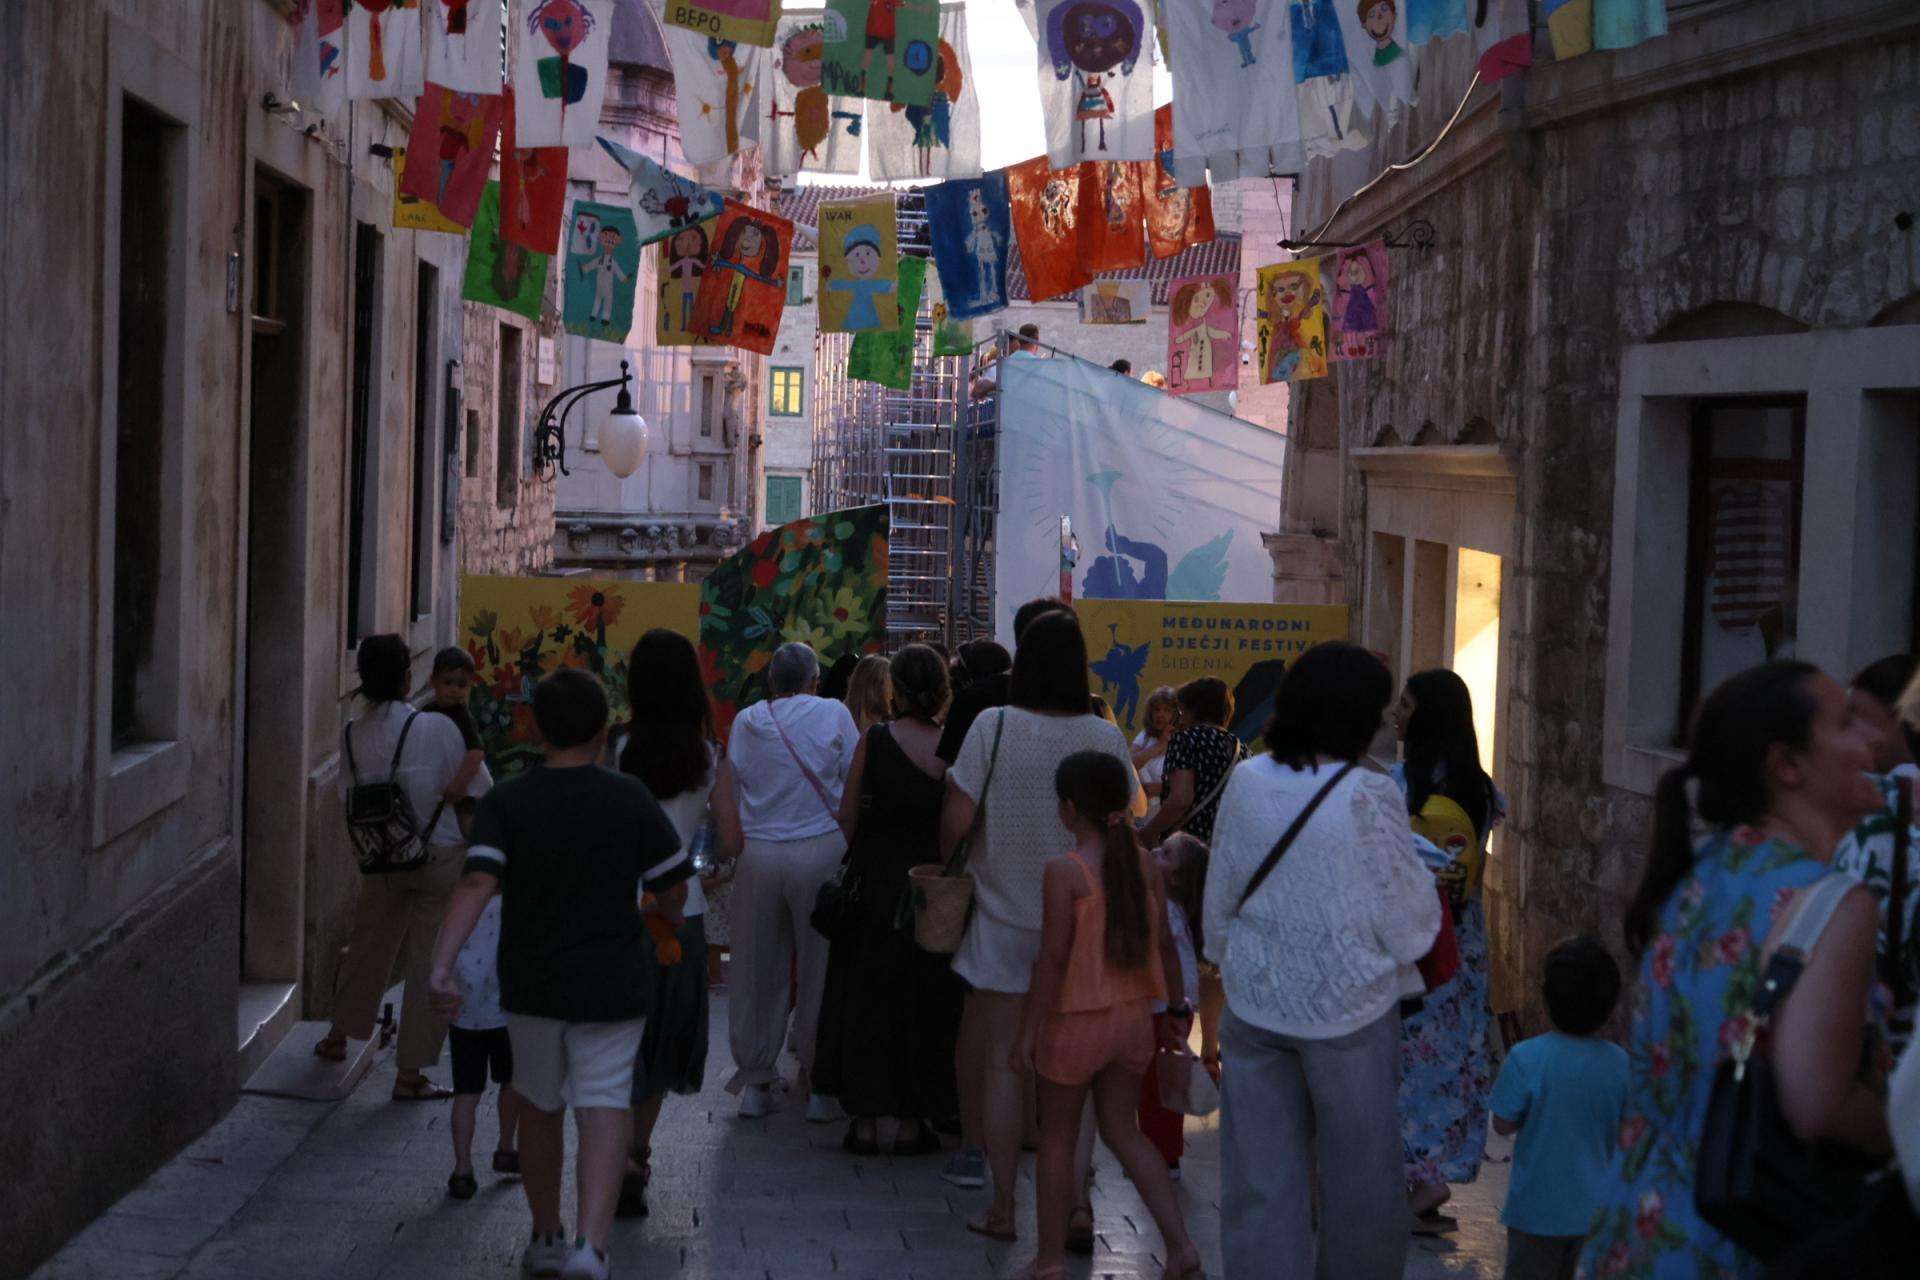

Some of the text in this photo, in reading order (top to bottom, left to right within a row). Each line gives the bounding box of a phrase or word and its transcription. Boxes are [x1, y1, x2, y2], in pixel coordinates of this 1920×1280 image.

[675, 6, 720, 33] BEPO
[1162, 617, 1312, 632] MEĐUNARODNI
[1162, 635, 1314, 651] DJEČJI FESTIV
